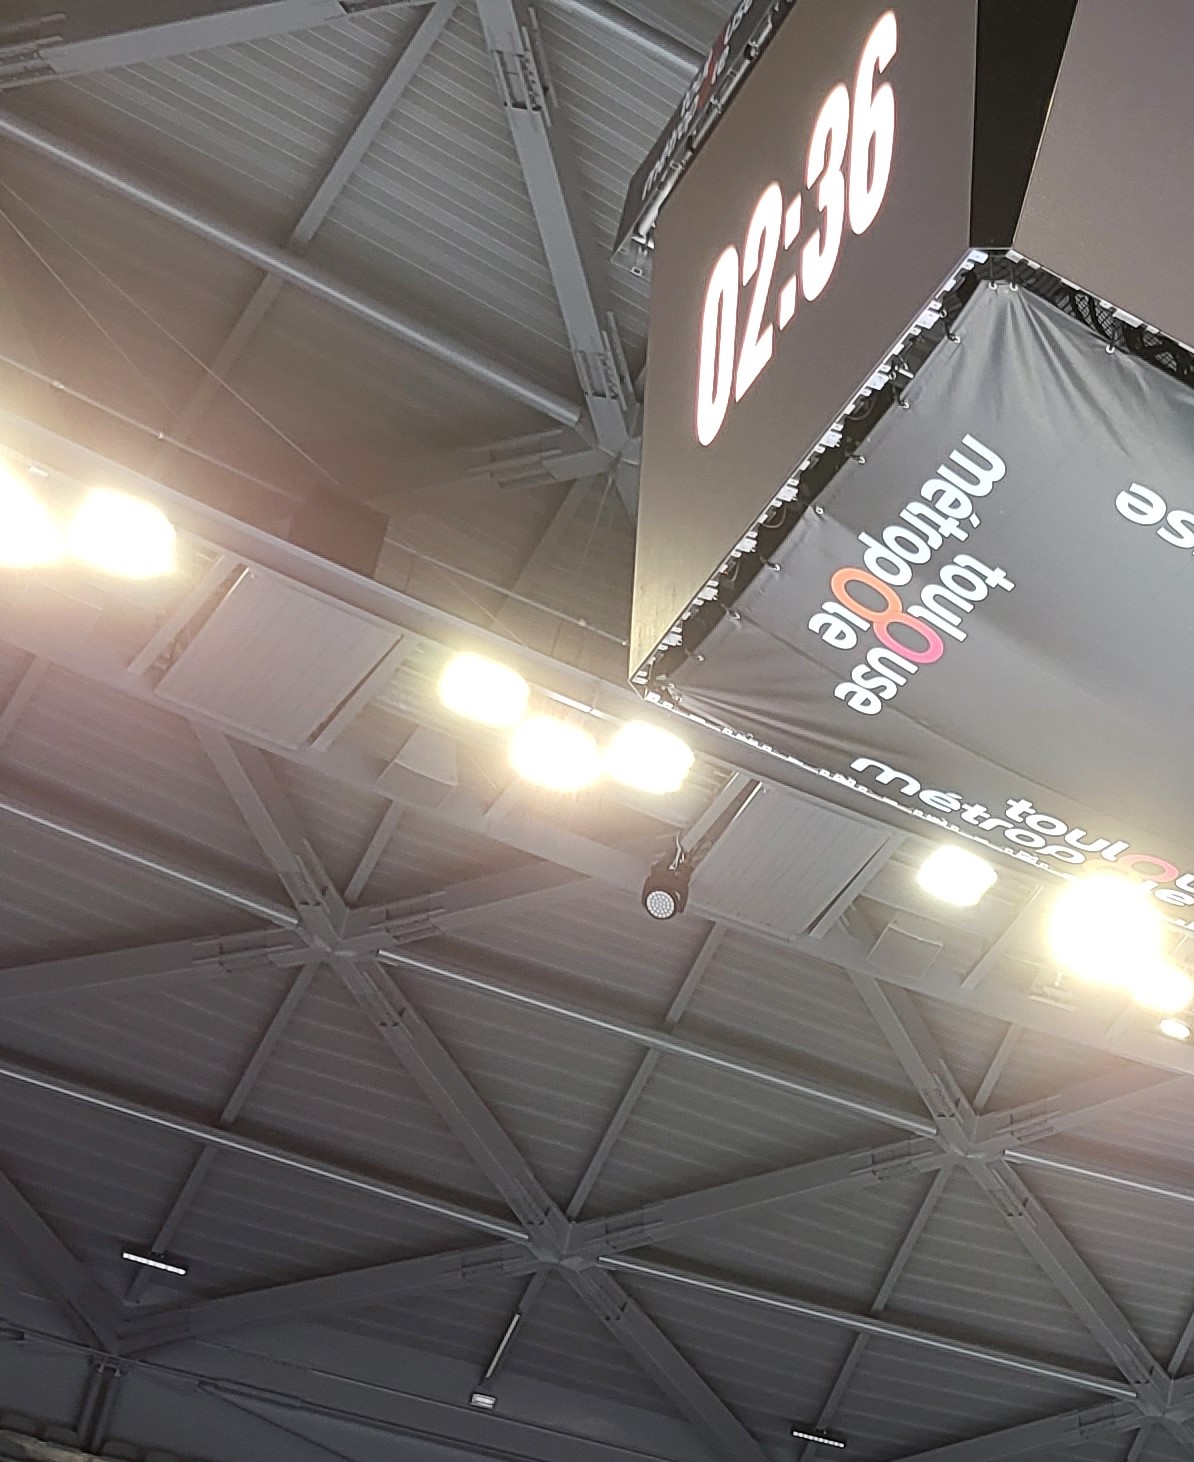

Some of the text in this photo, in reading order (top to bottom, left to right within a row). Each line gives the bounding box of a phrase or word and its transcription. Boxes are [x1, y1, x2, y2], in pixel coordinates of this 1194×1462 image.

[697, 10, 898, 446] 02:36
[807, 433, 1006, 650] métropole
[833, 554, 1015, 715] toulouse
